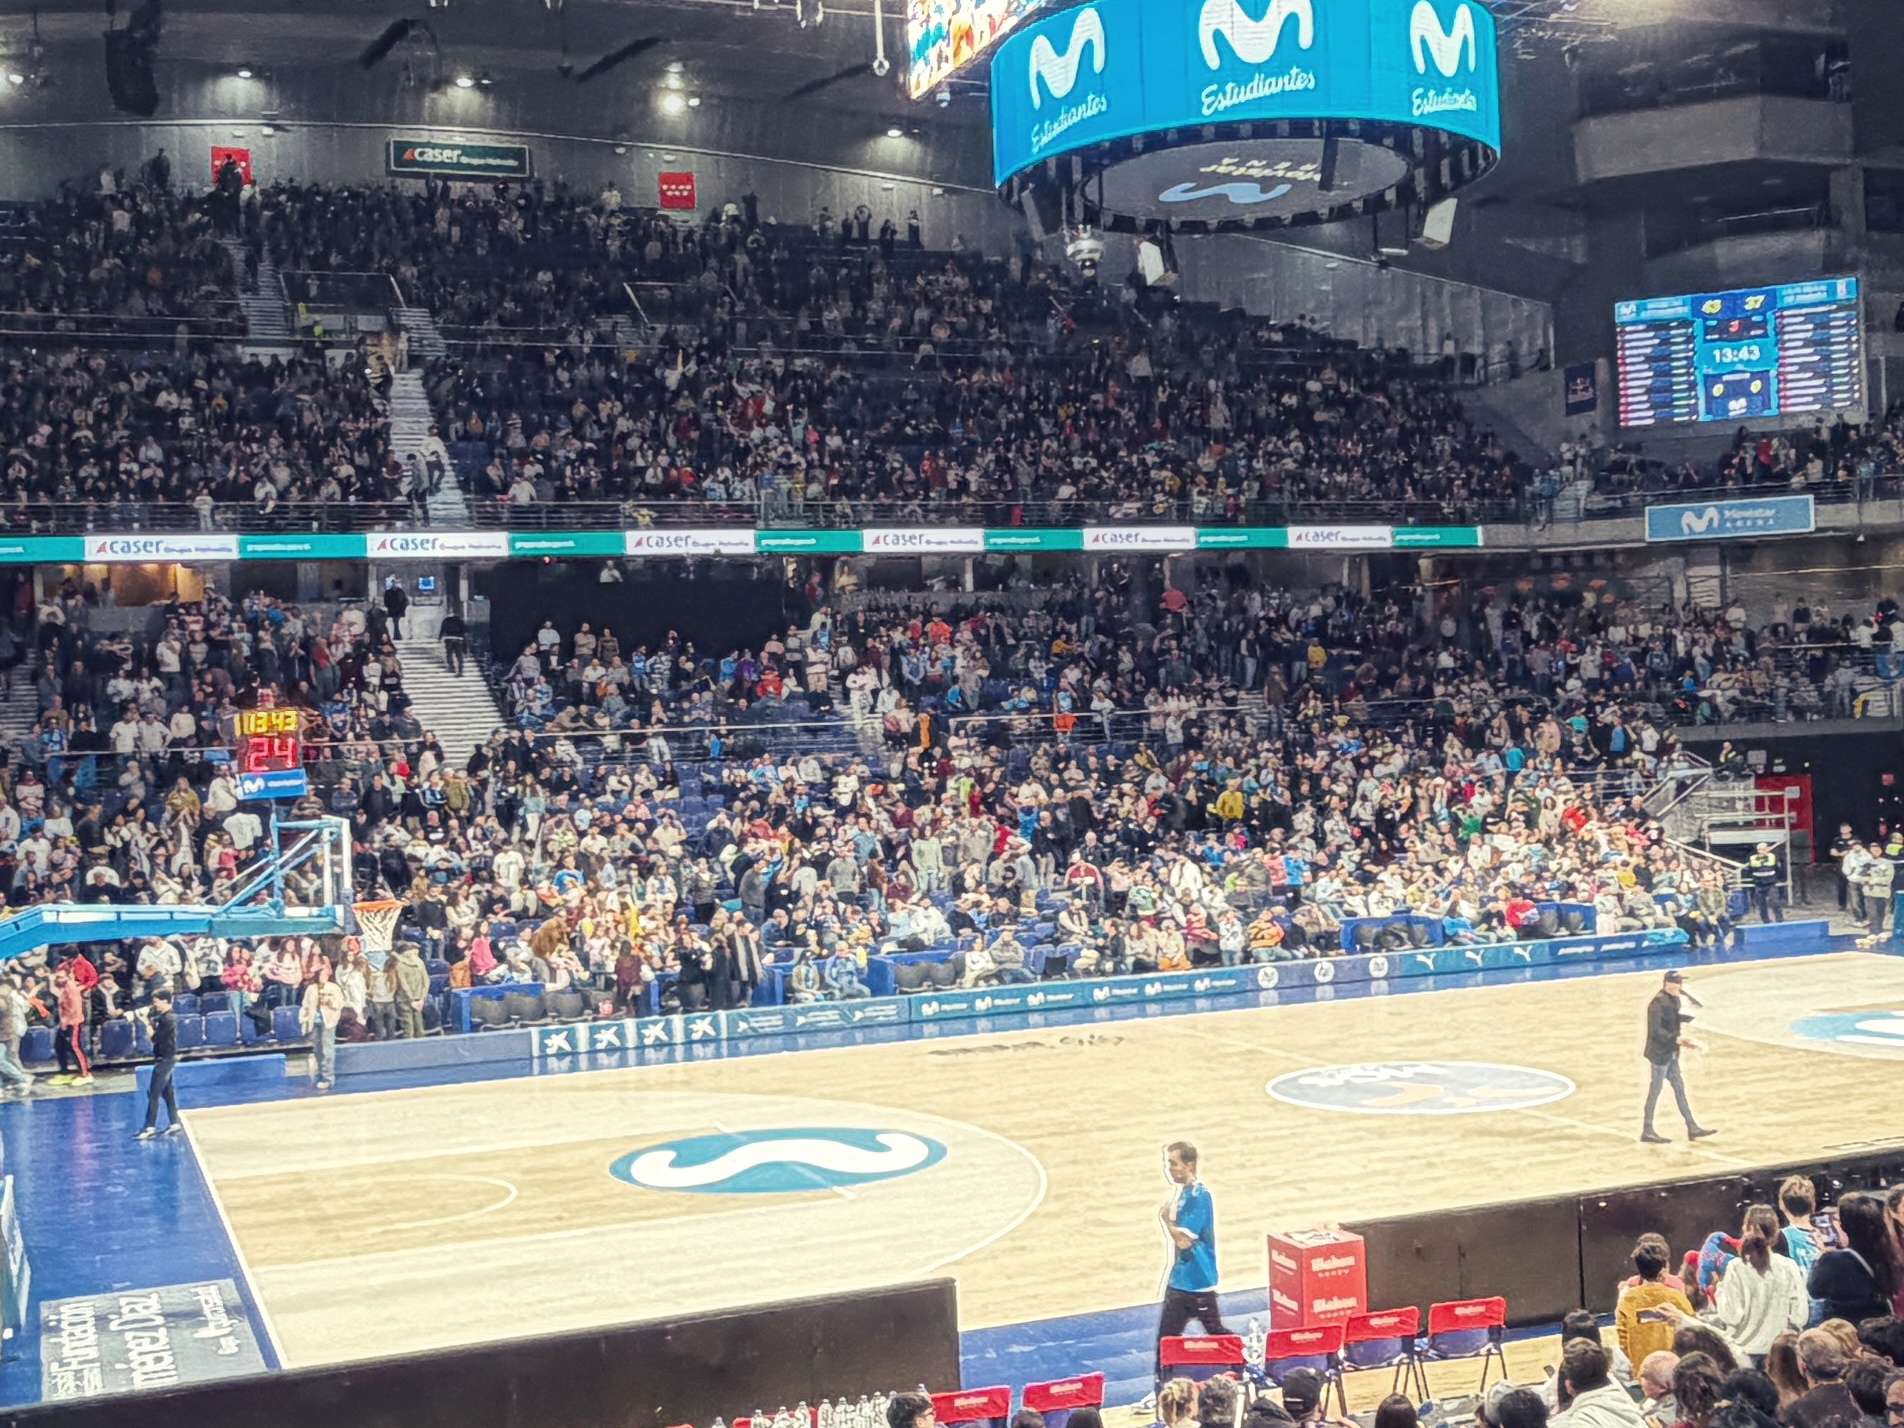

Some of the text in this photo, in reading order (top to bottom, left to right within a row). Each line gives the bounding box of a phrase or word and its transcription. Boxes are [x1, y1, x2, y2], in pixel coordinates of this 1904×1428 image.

[1201, 65, 1316, 115] Estudiantes
[414, 148, 461, 163] caser
[1713, 345, 1761, 363] 13:43
[389, 537, 440, 551] caser
[645, 535, 691, 548] caser
[883, 533, 924, 545] caser
[1101, 531, 1141, 543] caser
[109, 539, 164, 554] caser
[249, 737, 295, 771] 24
